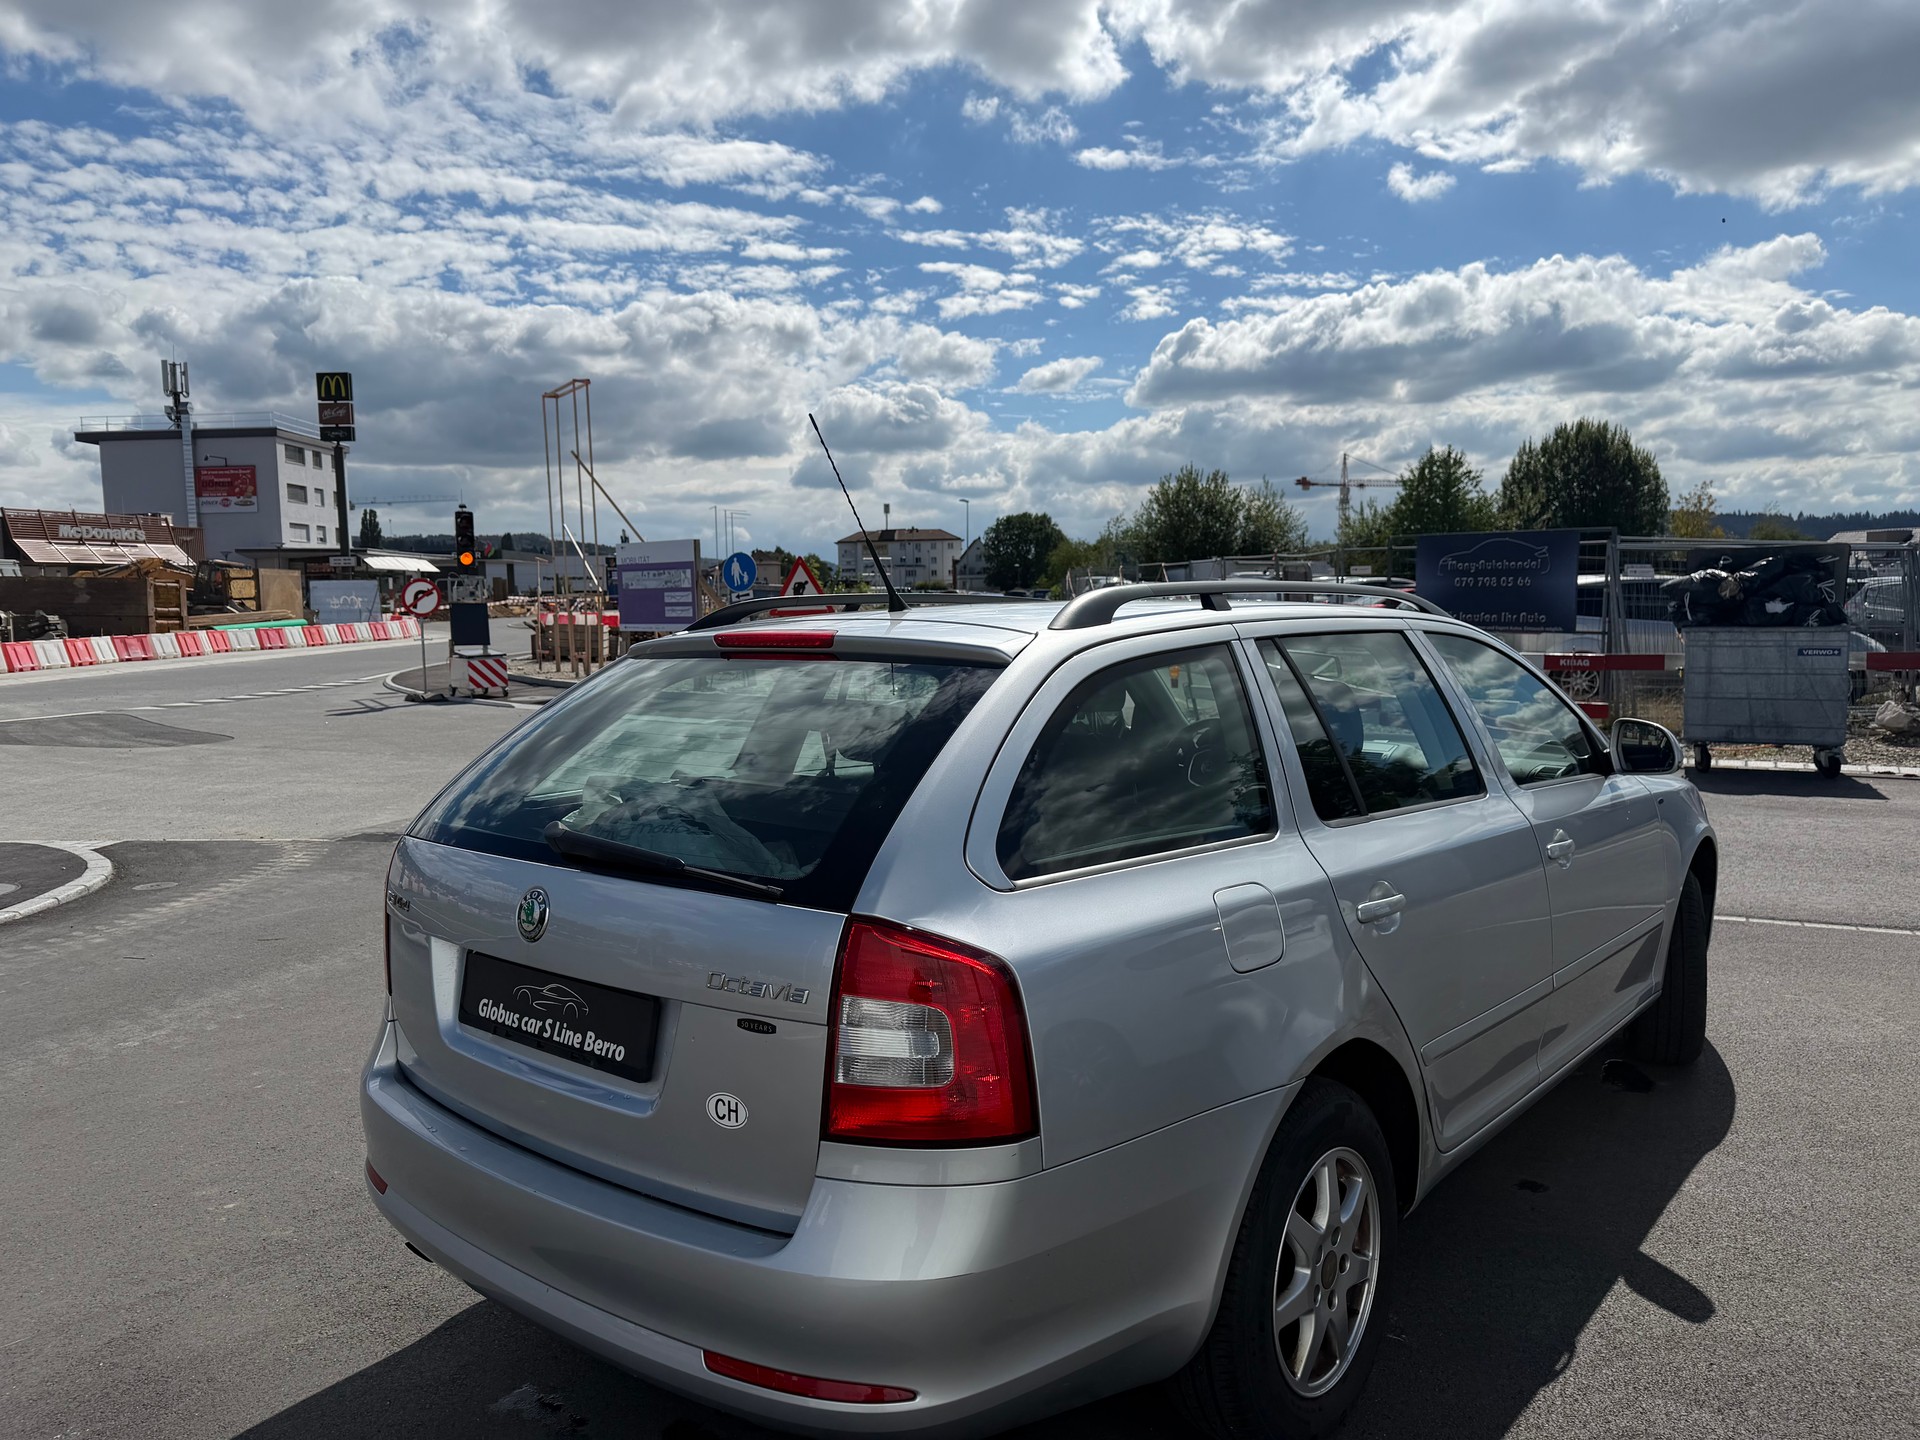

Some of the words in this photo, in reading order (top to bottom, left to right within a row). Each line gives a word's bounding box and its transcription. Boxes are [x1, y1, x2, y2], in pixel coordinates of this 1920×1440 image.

[58, 524, 146, 541] McDonald's
[1454, 577, 1474, 587] 079
[1478, 577, 1497, 587] 798
[1500, 576, 1514, 587] 05
[1517, 576, 1531, 587] 66
[1459, 611, 1498, 623] kaufen
[1501, 611, 1517, 623] Ihr
[1519, 611, 1547, 623] Auto
[1559, 658, 1590, 667] KIBAG
[706, 970, 810, 1005] Octavia
[478, 998, 520, 1029] Globus
[521, 1016, 543, 1036] car
[543, 1018, 553, 1039] S
[552, 1021, 583, 1049] Line
[583, 1030, 625, 1062] Berro
[741, 1020, 750, 1028] 50
[750, 1022, 772, 1033] YEARS
[714, 1098, 739, 1124] CH
